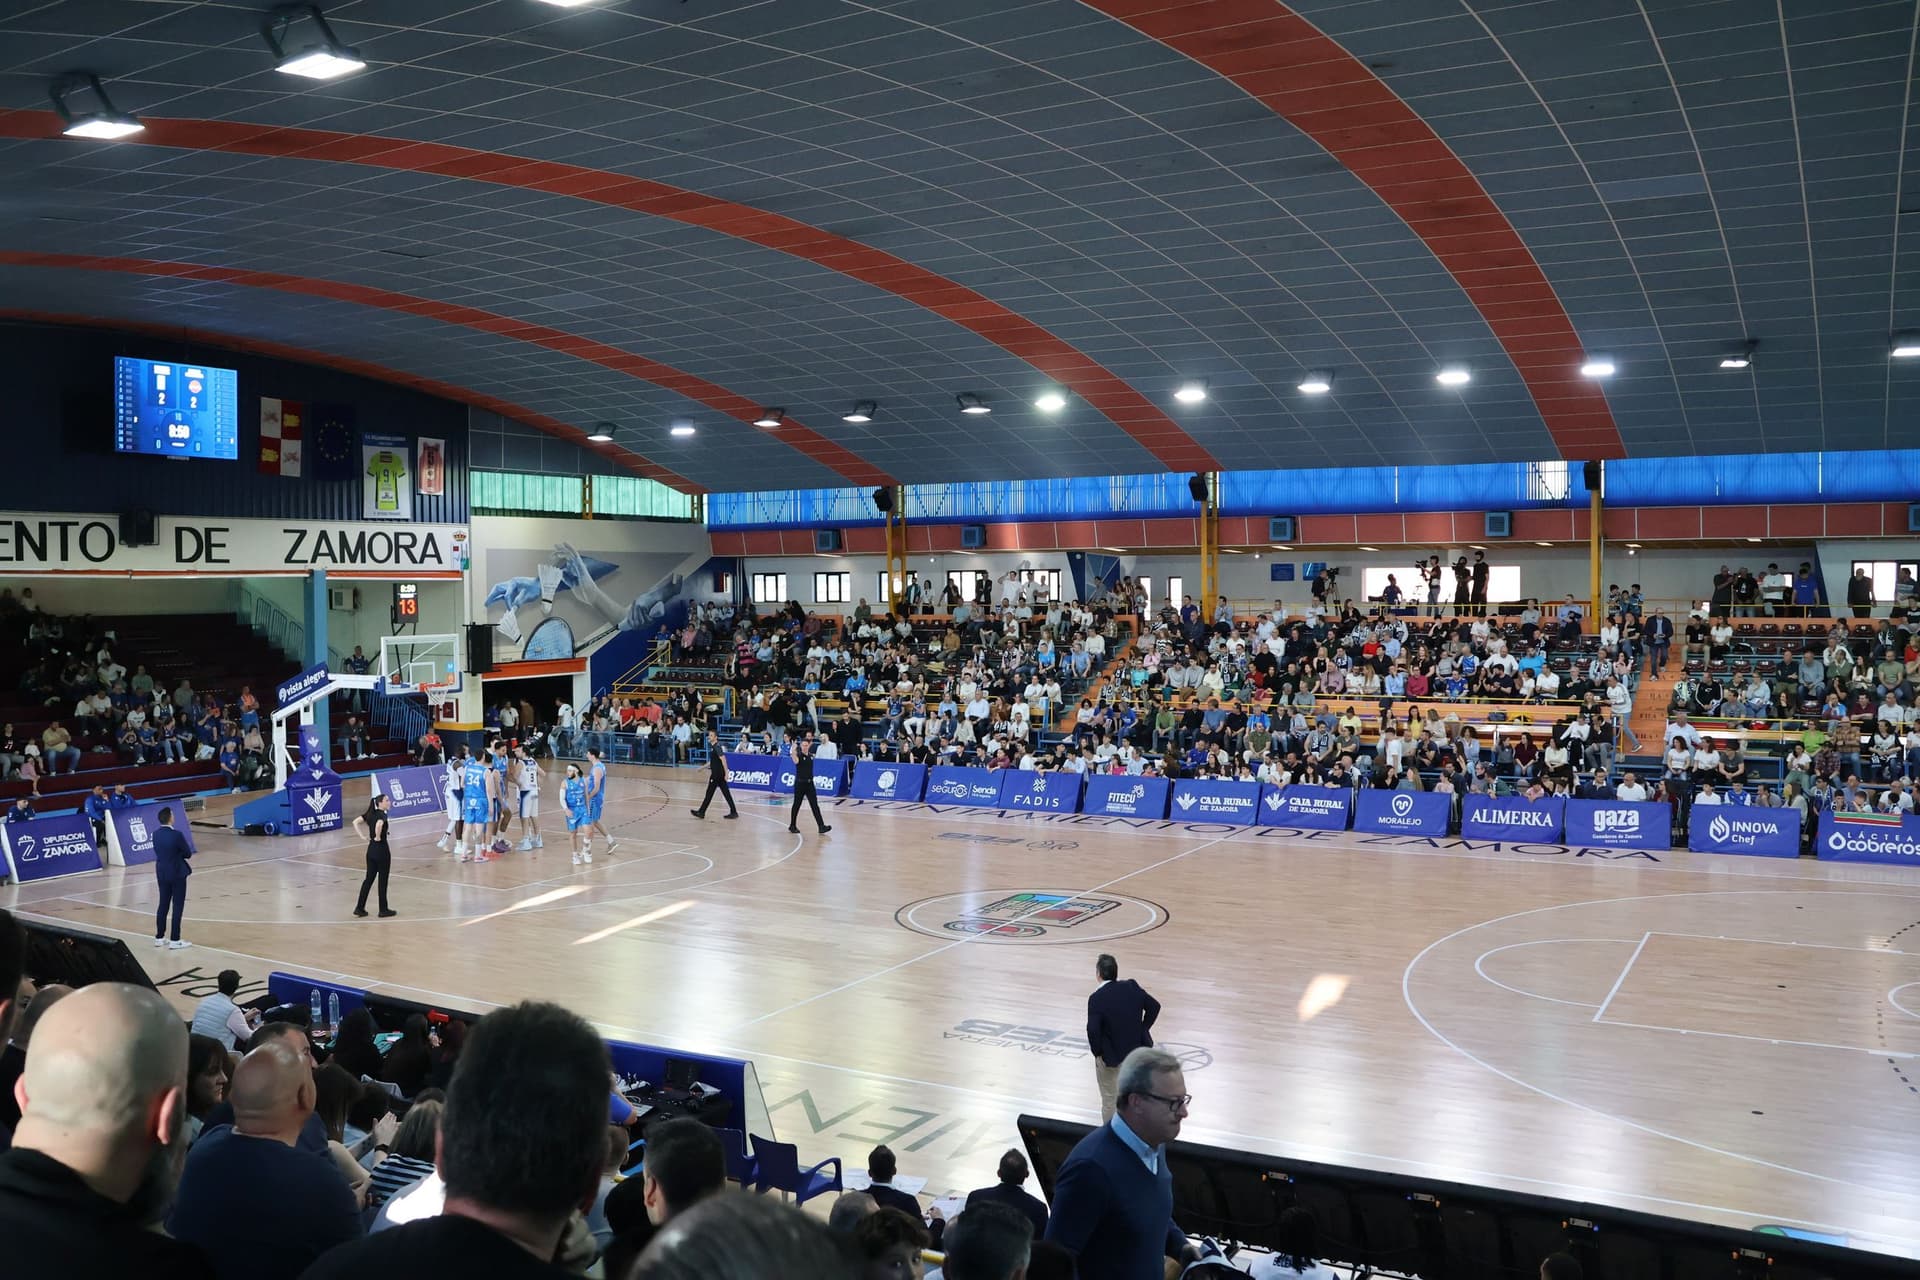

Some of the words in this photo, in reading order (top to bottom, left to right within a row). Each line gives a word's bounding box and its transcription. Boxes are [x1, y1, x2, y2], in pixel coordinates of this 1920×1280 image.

[158, 392, 166, 405] 2
[190, 396, 198, 409] 2
[174, 526, 230, 563] DE
[283, 529, 443, 564] ZAMORA
[399, 599, 417, 615] 13
[287, 682, 304, 696] vista
[303, 670, 326, 687] alegre
[466, 773, 480, 786] 34
[781, 772, 796, 787] CB
[405, 791, 421, 799] Junta
[972, 785, 997, 795] Senda
[392, 799, 413, 808] Castilla
[416, 796, 432, 804] León
[1013, 794, 1060, 808] FADIS
[1200, 796, 1221, 805] CAJA
[1223, 797, 1254, 808] RURAL
[1289, 797, 1312, 807] CAJA
[1313, 799, 1345, 809] RURAL
[1300, 807, 1329, 815] ZAMORA
[1471, 808, 1554, 827] ALIMERKA
[298, 816, 316, 826] CAJA
[1378, 816, 1422, 826] MORALEJO
[1594, 810, 1639, 832] gaza
[1732, 821, 1779, 834] INNOVA
[1255, 828, 1344, 841] DE
[1355, 834, 1661, 862] ZAMORA
[1731, 834, 1756, 846] Chef
[42, 842, 93, 858] ZAMORA
[943, 1031, 1089, 1060] PRIMERA
